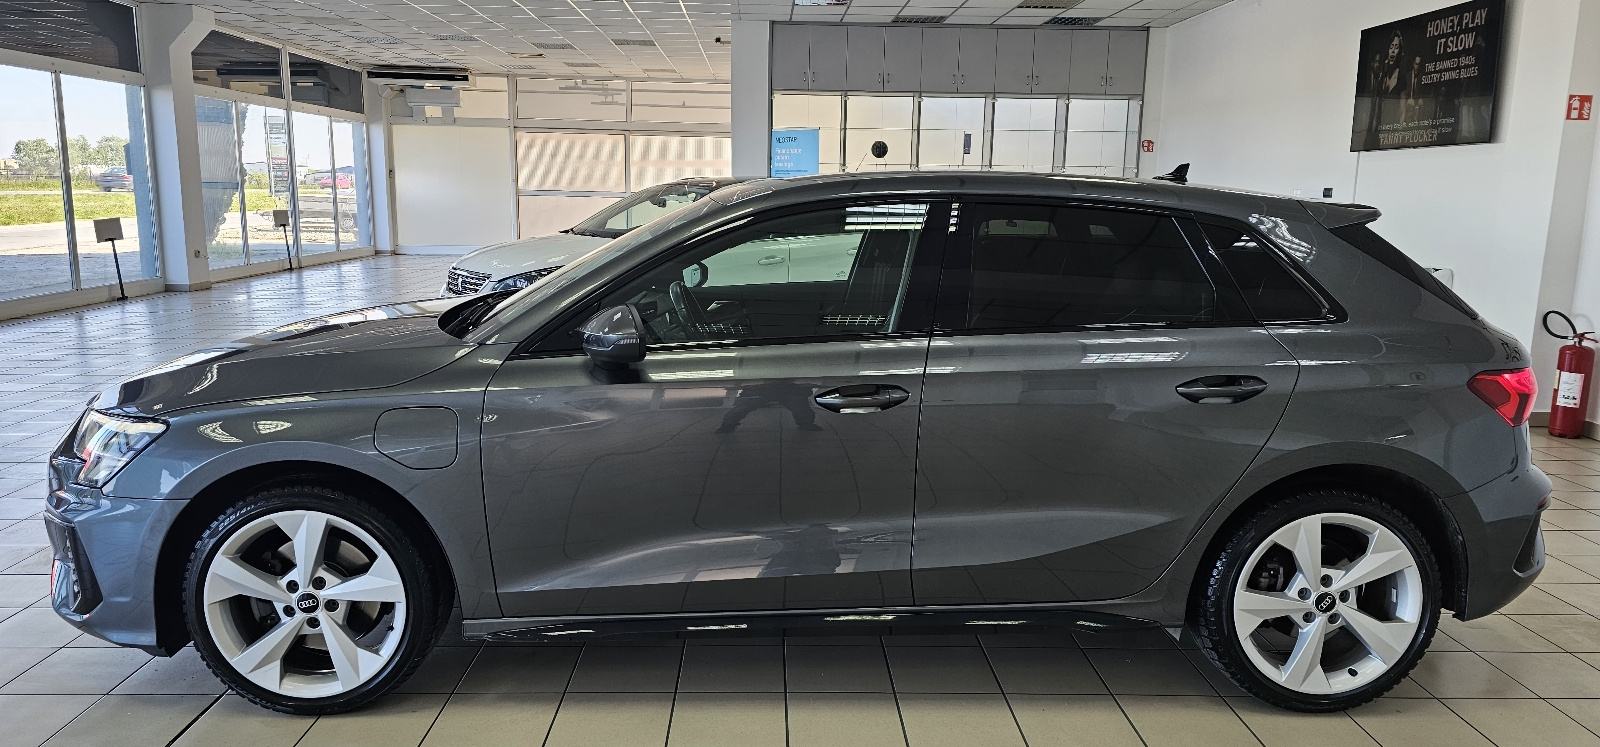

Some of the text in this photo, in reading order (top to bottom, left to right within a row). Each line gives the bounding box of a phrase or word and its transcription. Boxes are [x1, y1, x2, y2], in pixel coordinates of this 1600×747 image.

[1426, 7, 1488, 38] HONEY, PLAY
[1436, 31, 1476, 55] IT SLOW
[1421, 66, 1479, 84] SULTRY SWING BLUES
[1425, 61, 1436, 72] THE
[1435, 58, 1458, 71] BANNED
